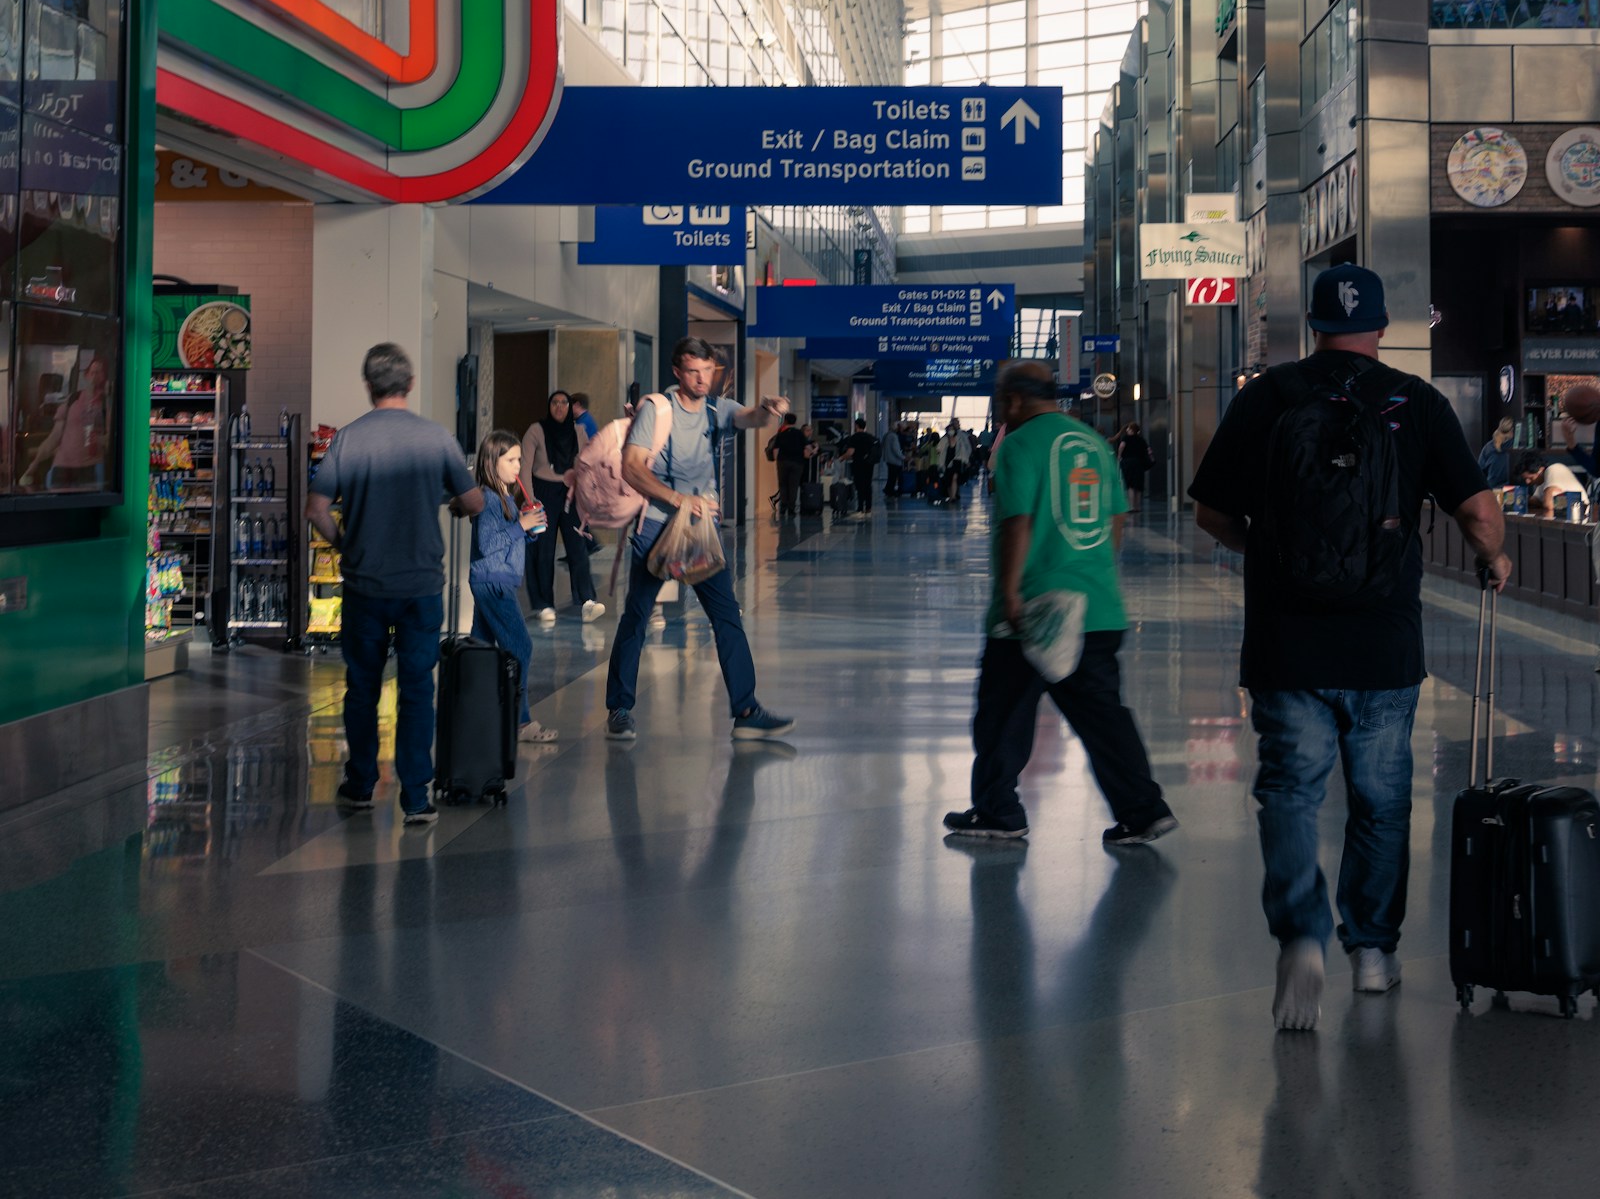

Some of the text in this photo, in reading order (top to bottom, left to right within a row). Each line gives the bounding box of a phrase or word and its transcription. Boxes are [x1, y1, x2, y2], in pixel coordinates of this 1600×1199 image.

[872, 99, 951, 120] Toilets
[761, 128, 950, 155] Exit / Bag Claim
[687, 158, 951, 184] Ground Transportation
[672, 230, 731, 247] Toilets
[1145, 245, 1244, 268] Flying Saucer
[898, 289, 966, 300] Gates D1-D12
[882, 302, 966, 316] Exit / Bag Claim
[849, 315, 966, 328] Ground Transportation
[891, 342, 927, 351] Terminal
[941, 342, 973, 353] Parking
